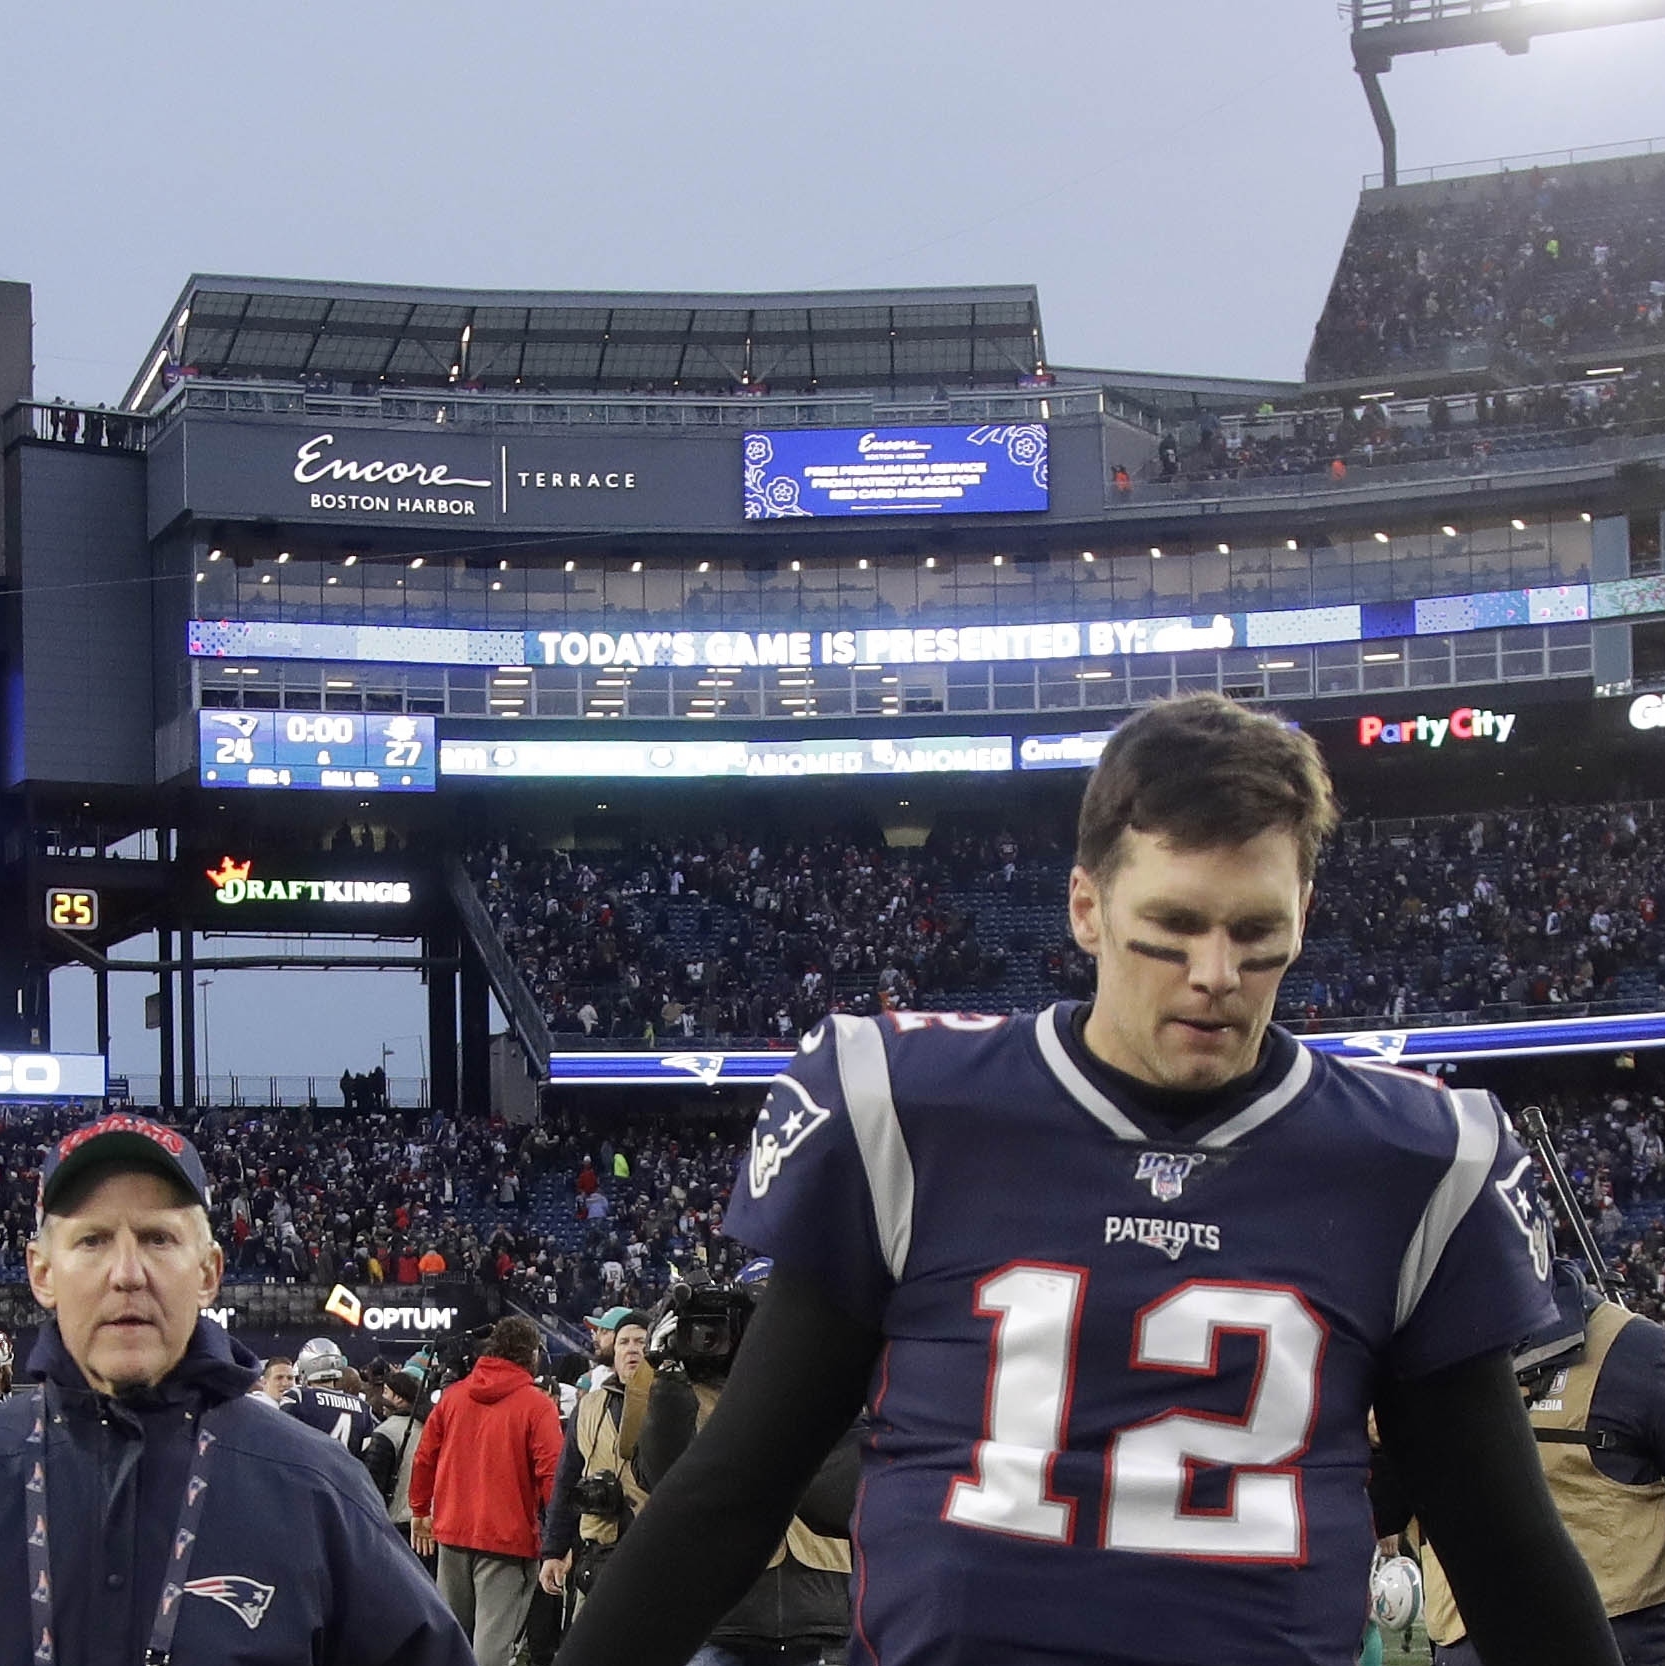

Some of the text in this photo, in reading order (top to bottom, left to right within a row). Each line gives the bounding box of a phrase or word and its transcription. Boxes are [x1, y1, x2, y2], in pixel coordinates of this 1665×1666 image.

[293, 434, 491, 487] Encore
[518, 473, 635, 488] TERRACE
[311, 493, 476, 515] BOSTON HARBOR
[538, 632, 694, 667] TODAY'S
[705, 632, 811, 666] GAME
[820, 631, 856, 664] IS
[867, 623, 1074, 664] PRESENTED
[1089, 619, 1147, 655] BY:
[287, 716, 353, 742] 0:00
[1359, 707, 1516, 746] Party City
[216, 737, 254, 763] 24
[385, 741, 422, 766] 27
[215, 875, 411, 904] DRAFTKINGS
[53, 894, 92, 925] 25
[1105, 1216, 1221, 1251] PATRIOTS
[364, 1307, 452, 1330] OPTUM
[316, 1391, 364, 1413] STIDHAM
[941, 1260, 1330, 1565] 12
